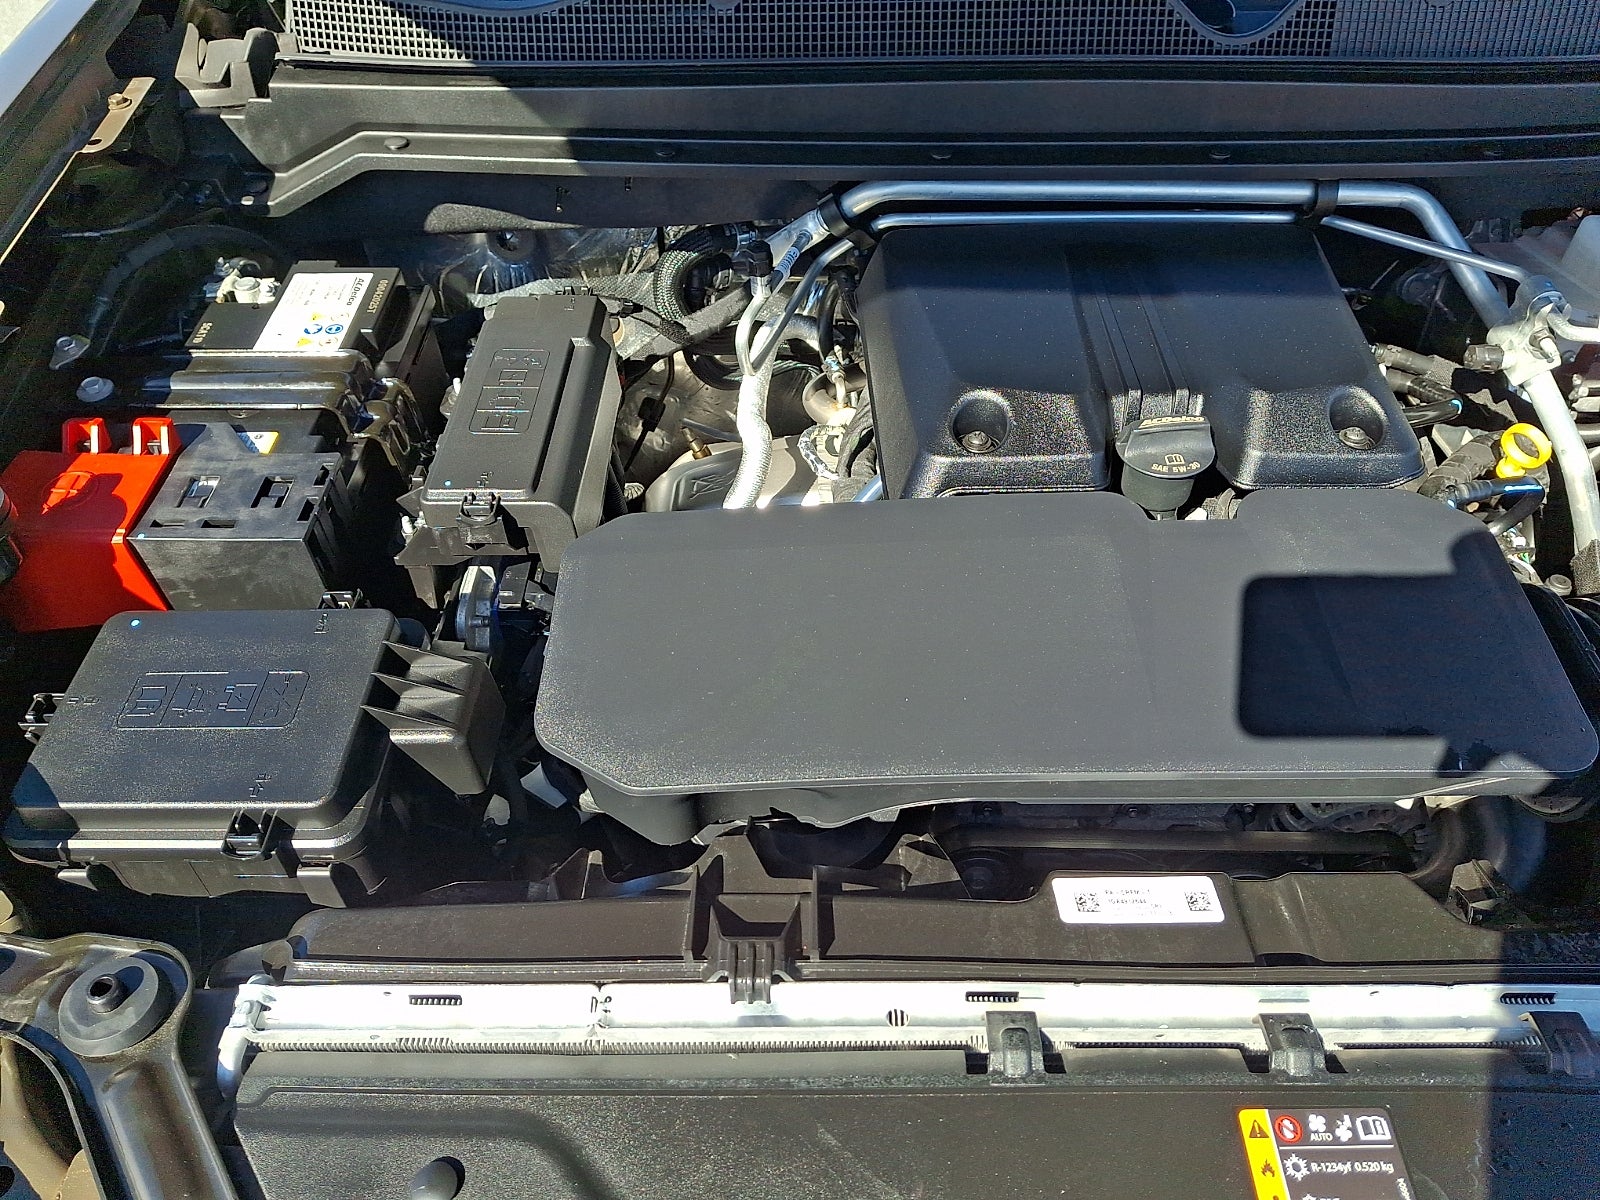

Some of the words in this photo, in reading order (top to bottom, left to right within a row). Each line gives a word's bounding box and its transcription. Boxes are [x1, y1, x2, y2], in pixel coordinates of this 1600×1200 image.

[347, 277, 365, 306] ACDelco
[1138, 415, 1205, 428] ACDelco
[1151, 463, 1169, 473] SAE
[1310, 1132, 1333, 1142] AUTO
[1311, 1161, 1352, 1175] R-1234yf
[1355, 1161, 1380, 1173] 0.520
[1381, 1161, 1394, 1174] kg
